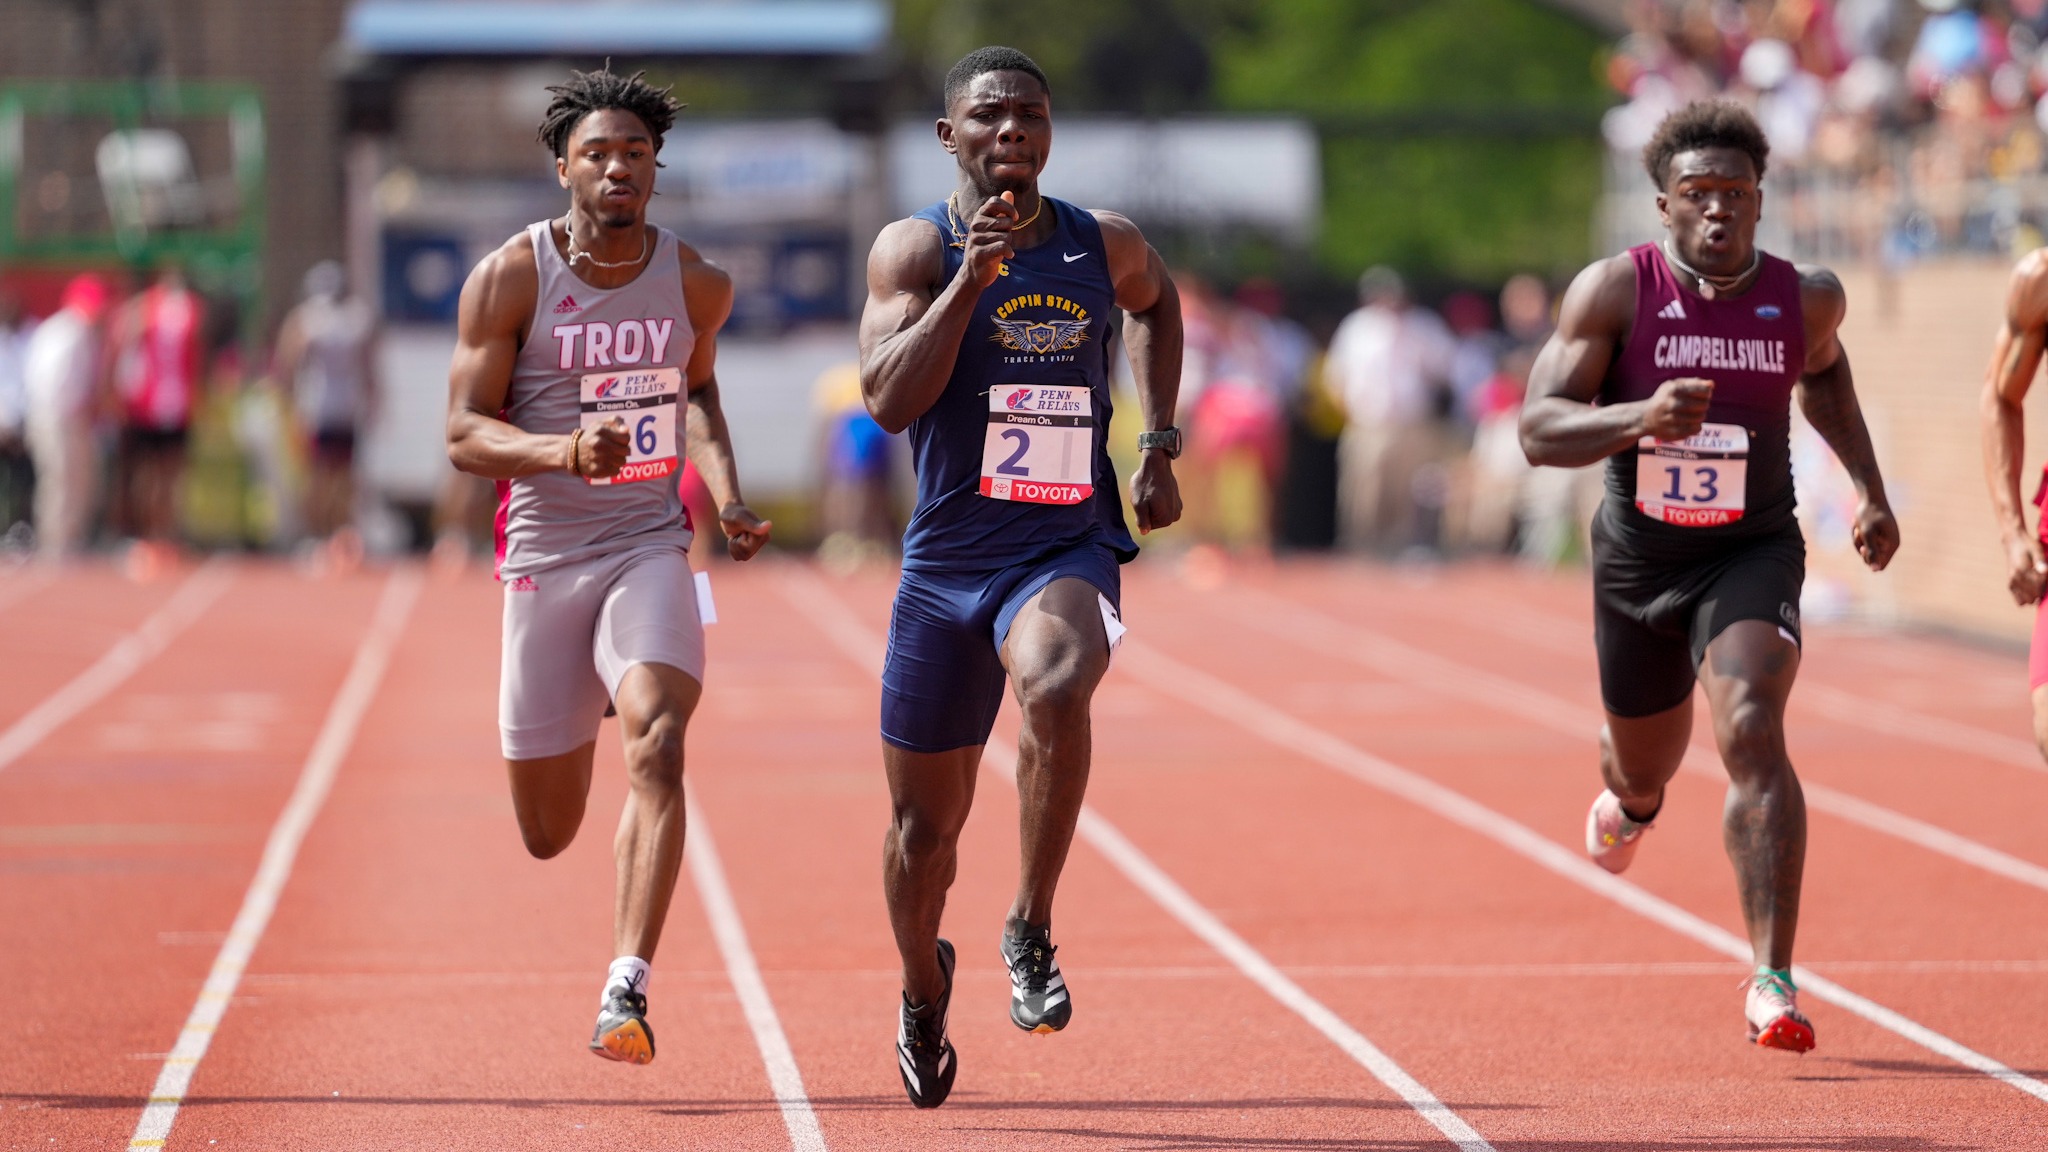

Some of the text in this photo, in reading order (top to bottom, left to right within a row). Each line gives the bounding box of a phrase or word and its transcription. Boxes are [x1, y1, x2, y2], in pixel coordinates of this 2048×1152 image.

[996, 293, 1087, 320] COPPIN STATE
[552, 317, 675, 370] TROY
[1654, 335, 1785, 374] CAMPBELLSVILLE
[627, 374, 658, 385] PENN
[624, 382, 667, 395] RELAYS
[1039, 389, 1072, 400] PENN
[597, 400, 640, 411] Dream On.
[1036, 400, 1080, 411] RELAYS
[1007, 414, 1052, 426] Dream On.
[628, 415, 657, 455] 6
[996, 428, 1031, 477] 2
[1015, 484, 1082, 501] TOYOTA
[1662, 466, 1718, 503] 13
[1666, 508, 1729, 525] TOYOTA
